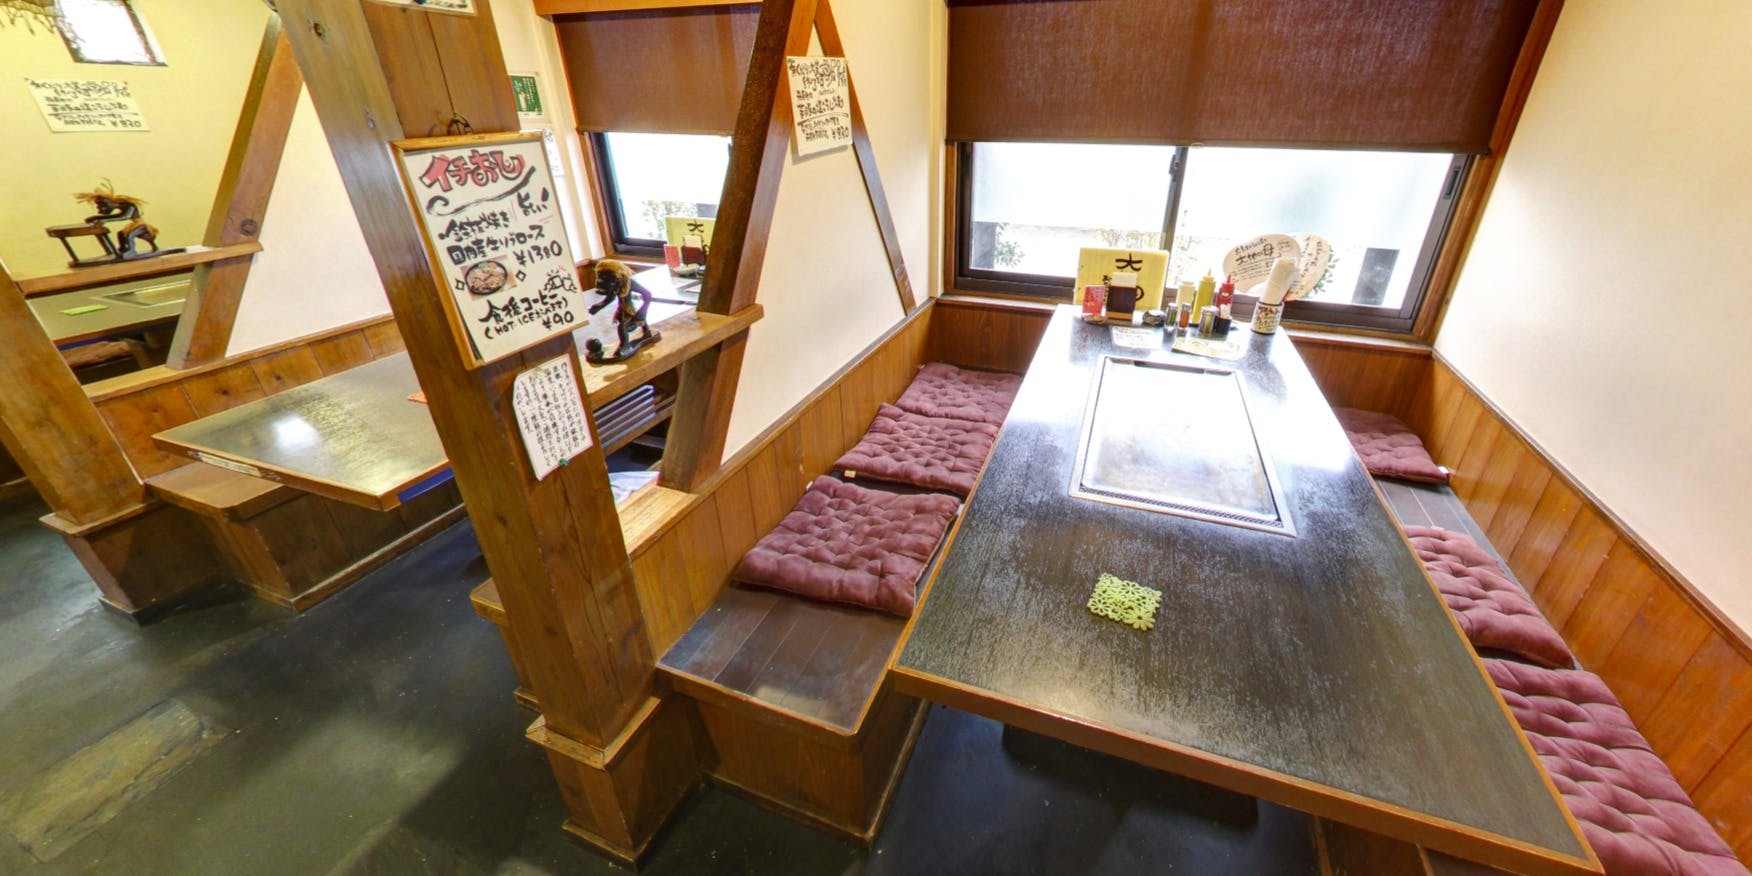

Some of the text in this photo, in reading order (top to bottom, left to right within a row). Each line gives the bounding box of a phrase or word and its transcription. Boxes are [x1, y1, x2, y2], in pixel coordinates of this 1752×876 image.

[419, 150, 526, 192] イチおし
[513, 240, 562, 267] ¥1380
[1115, 253, 1143, 271] 大
[542, 311, 574, 331] ¥90
